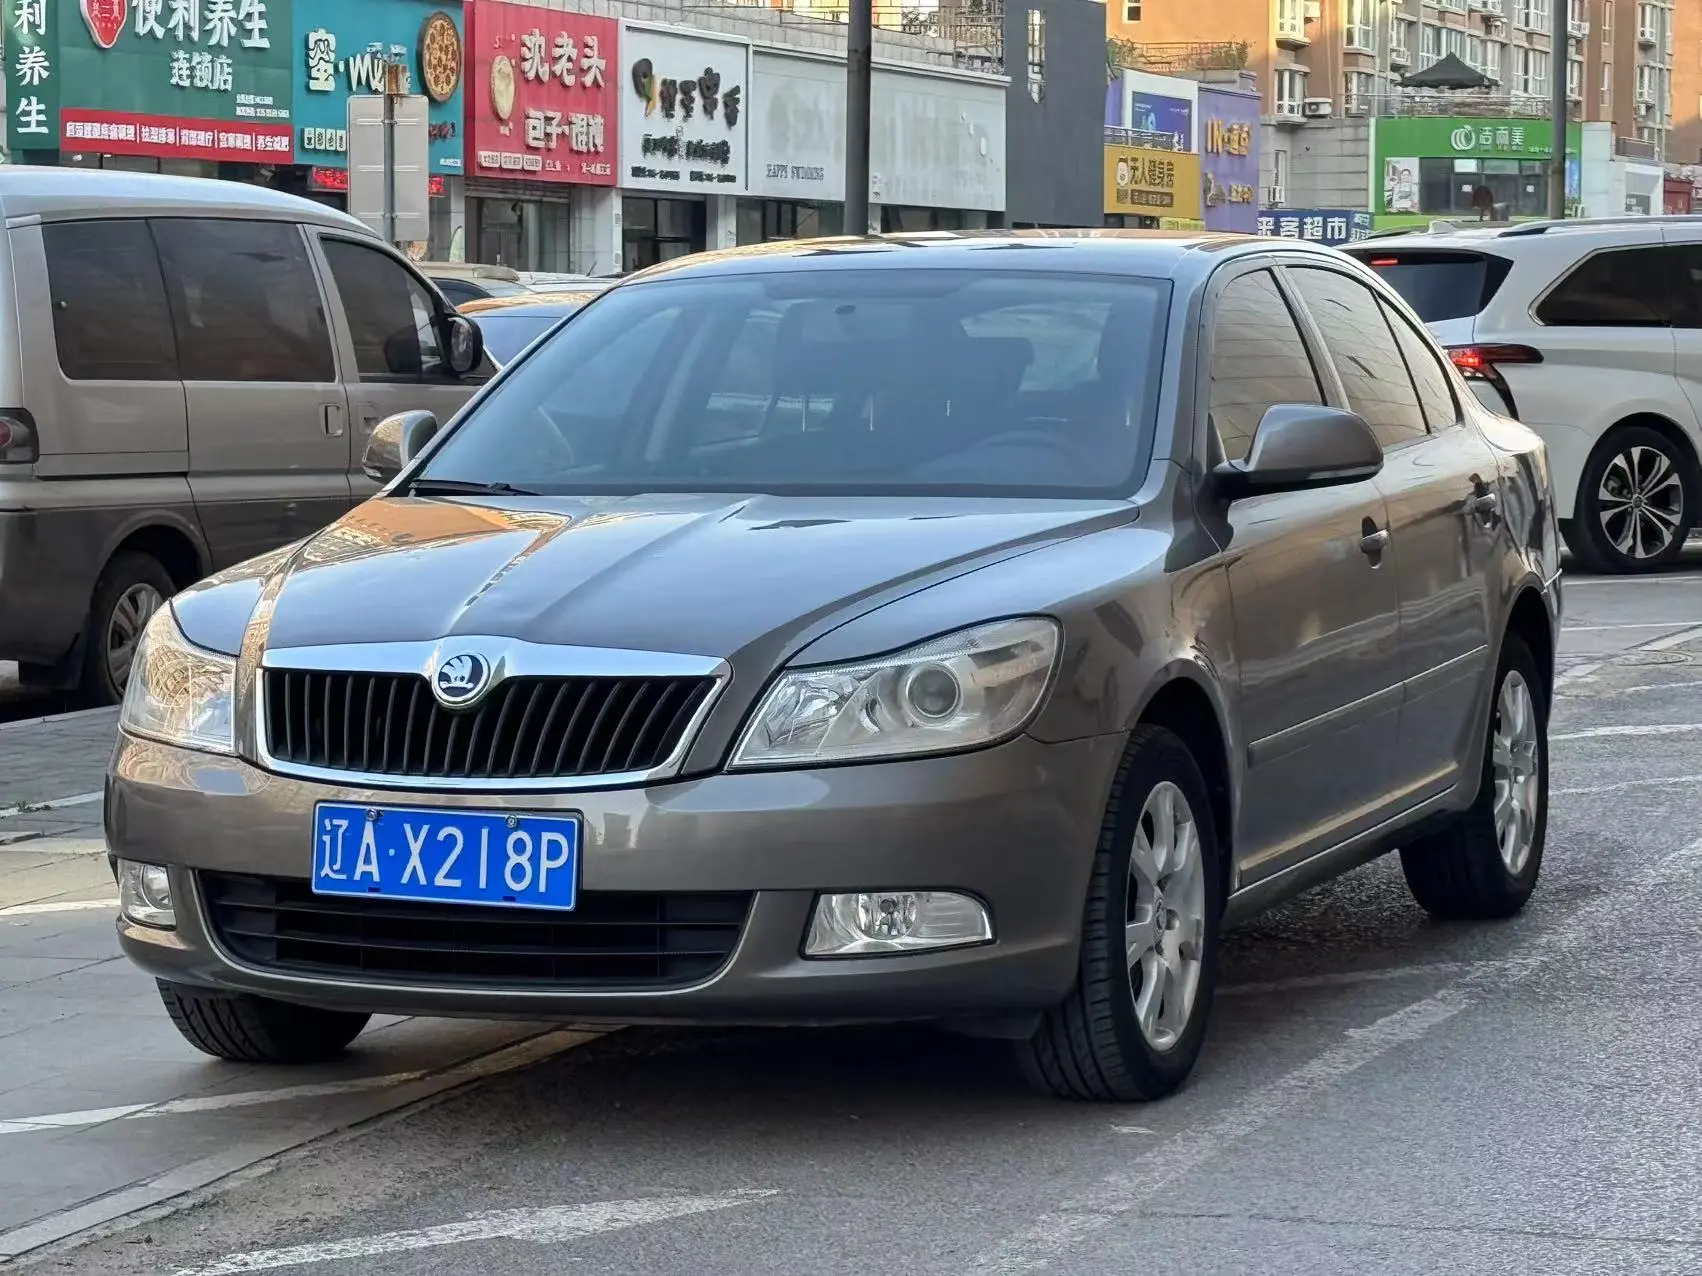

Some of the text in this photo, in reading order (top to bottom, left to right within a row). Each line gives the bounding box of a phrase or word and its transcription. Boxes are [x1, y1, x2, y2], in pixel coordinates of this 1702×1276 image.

[131, 0, 271, 49] 便利养生
[13, 0, 50, 134] 利养生
[169, 49, 233, 92] 连锁店
[321, 815, 569, 893] 辽A·X218P
